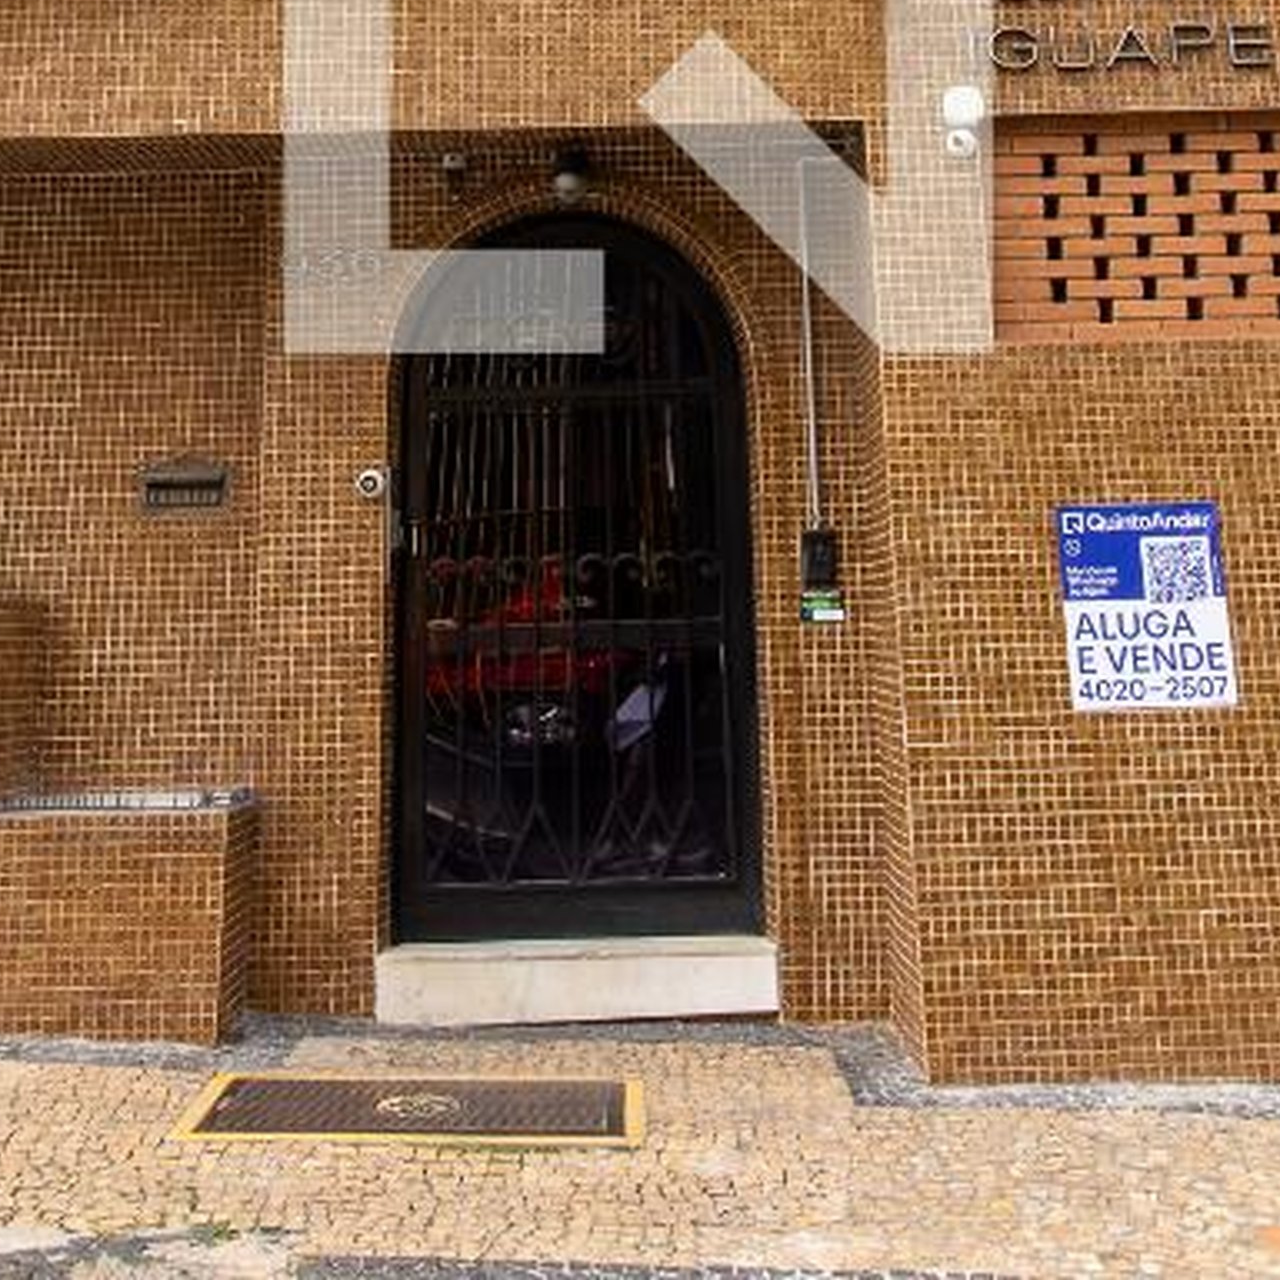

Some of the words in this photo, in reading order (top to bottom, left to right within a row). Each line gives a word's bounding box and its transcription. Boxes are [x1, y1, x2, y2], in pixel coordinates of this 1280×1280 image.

[1075, 609, 1196, 640] ALUGA
[1077, 646, 1097, 674] E
[1105, 642, 1227, 673] VENDE
[1079, 676, 1228, 701] 4020-2507
